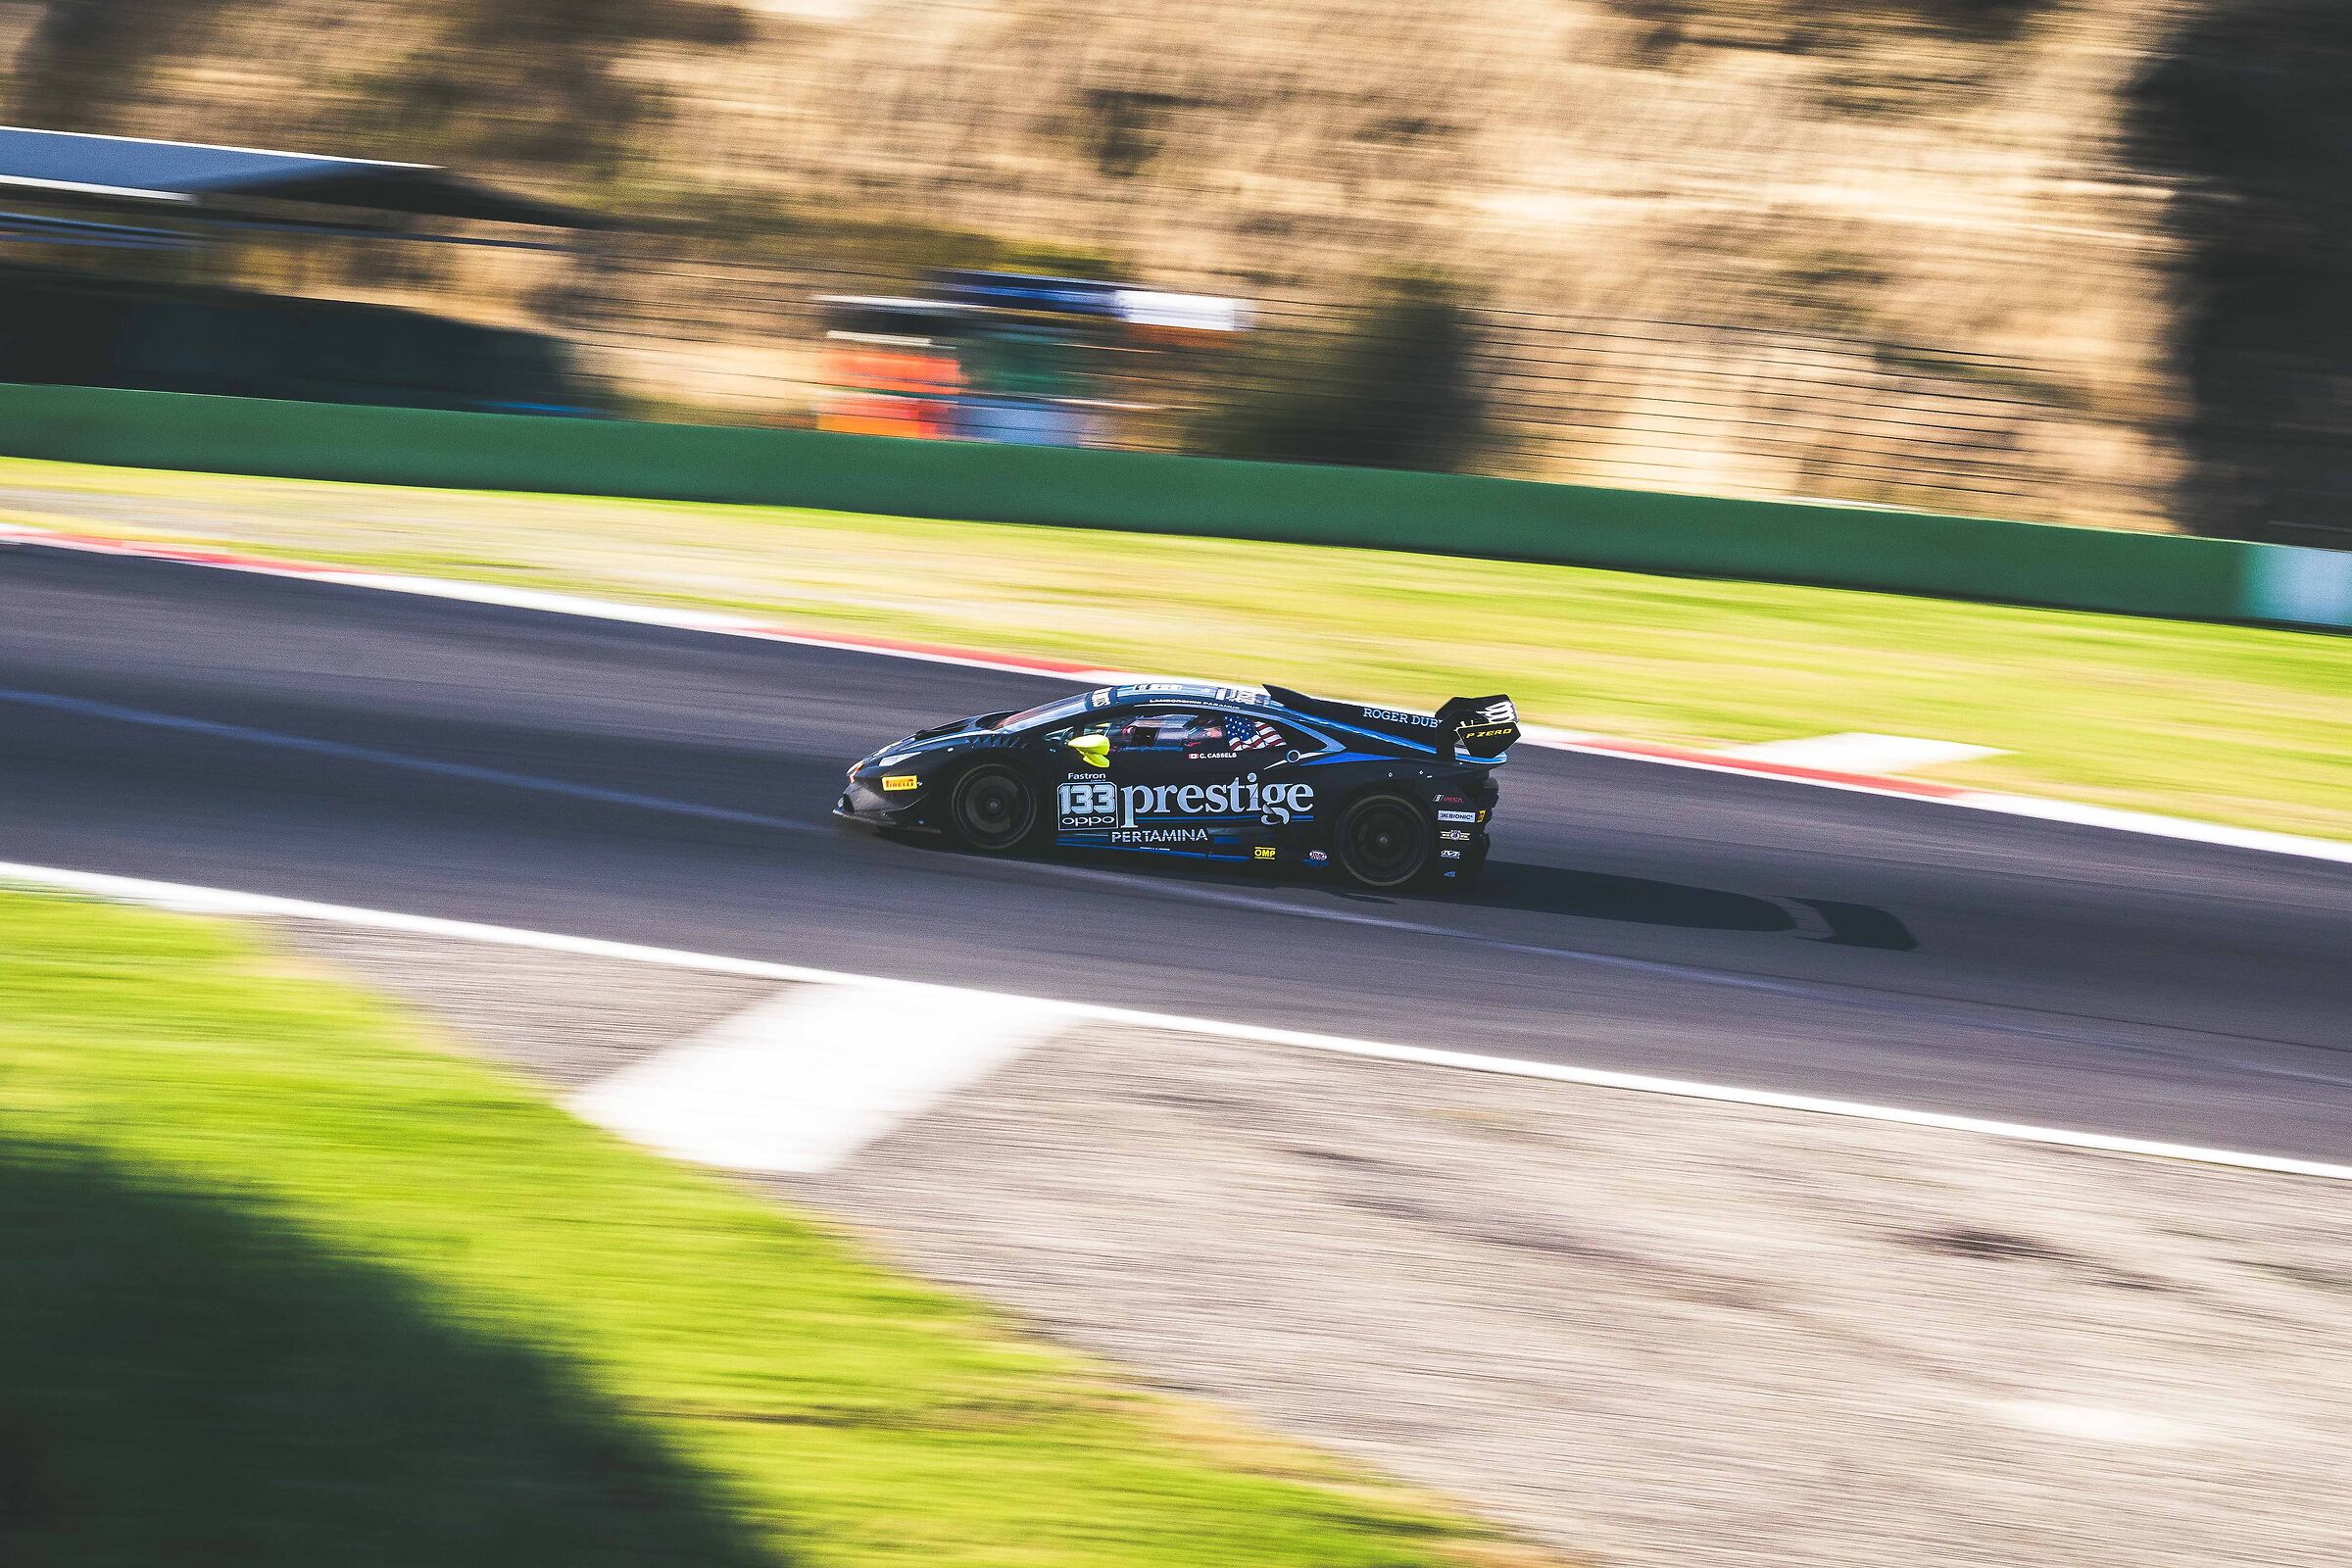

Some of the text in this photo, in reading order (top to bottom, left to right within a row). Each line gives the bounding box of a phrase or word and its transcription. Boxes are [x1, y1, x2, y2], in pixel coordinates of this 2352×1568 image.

[1363, 708, 1444, 728] ROGER DUB
[1477, 728, 1512, 738] ZERO
[1058, 784, 1115, 814] 133
[1120, 772, 1314, 828] prestige
[1061, 815, 1115, 827] oppo
[1111, 828, 1208, 843] PERTAMINA
[1254, 849, 1276, 858] OMP
